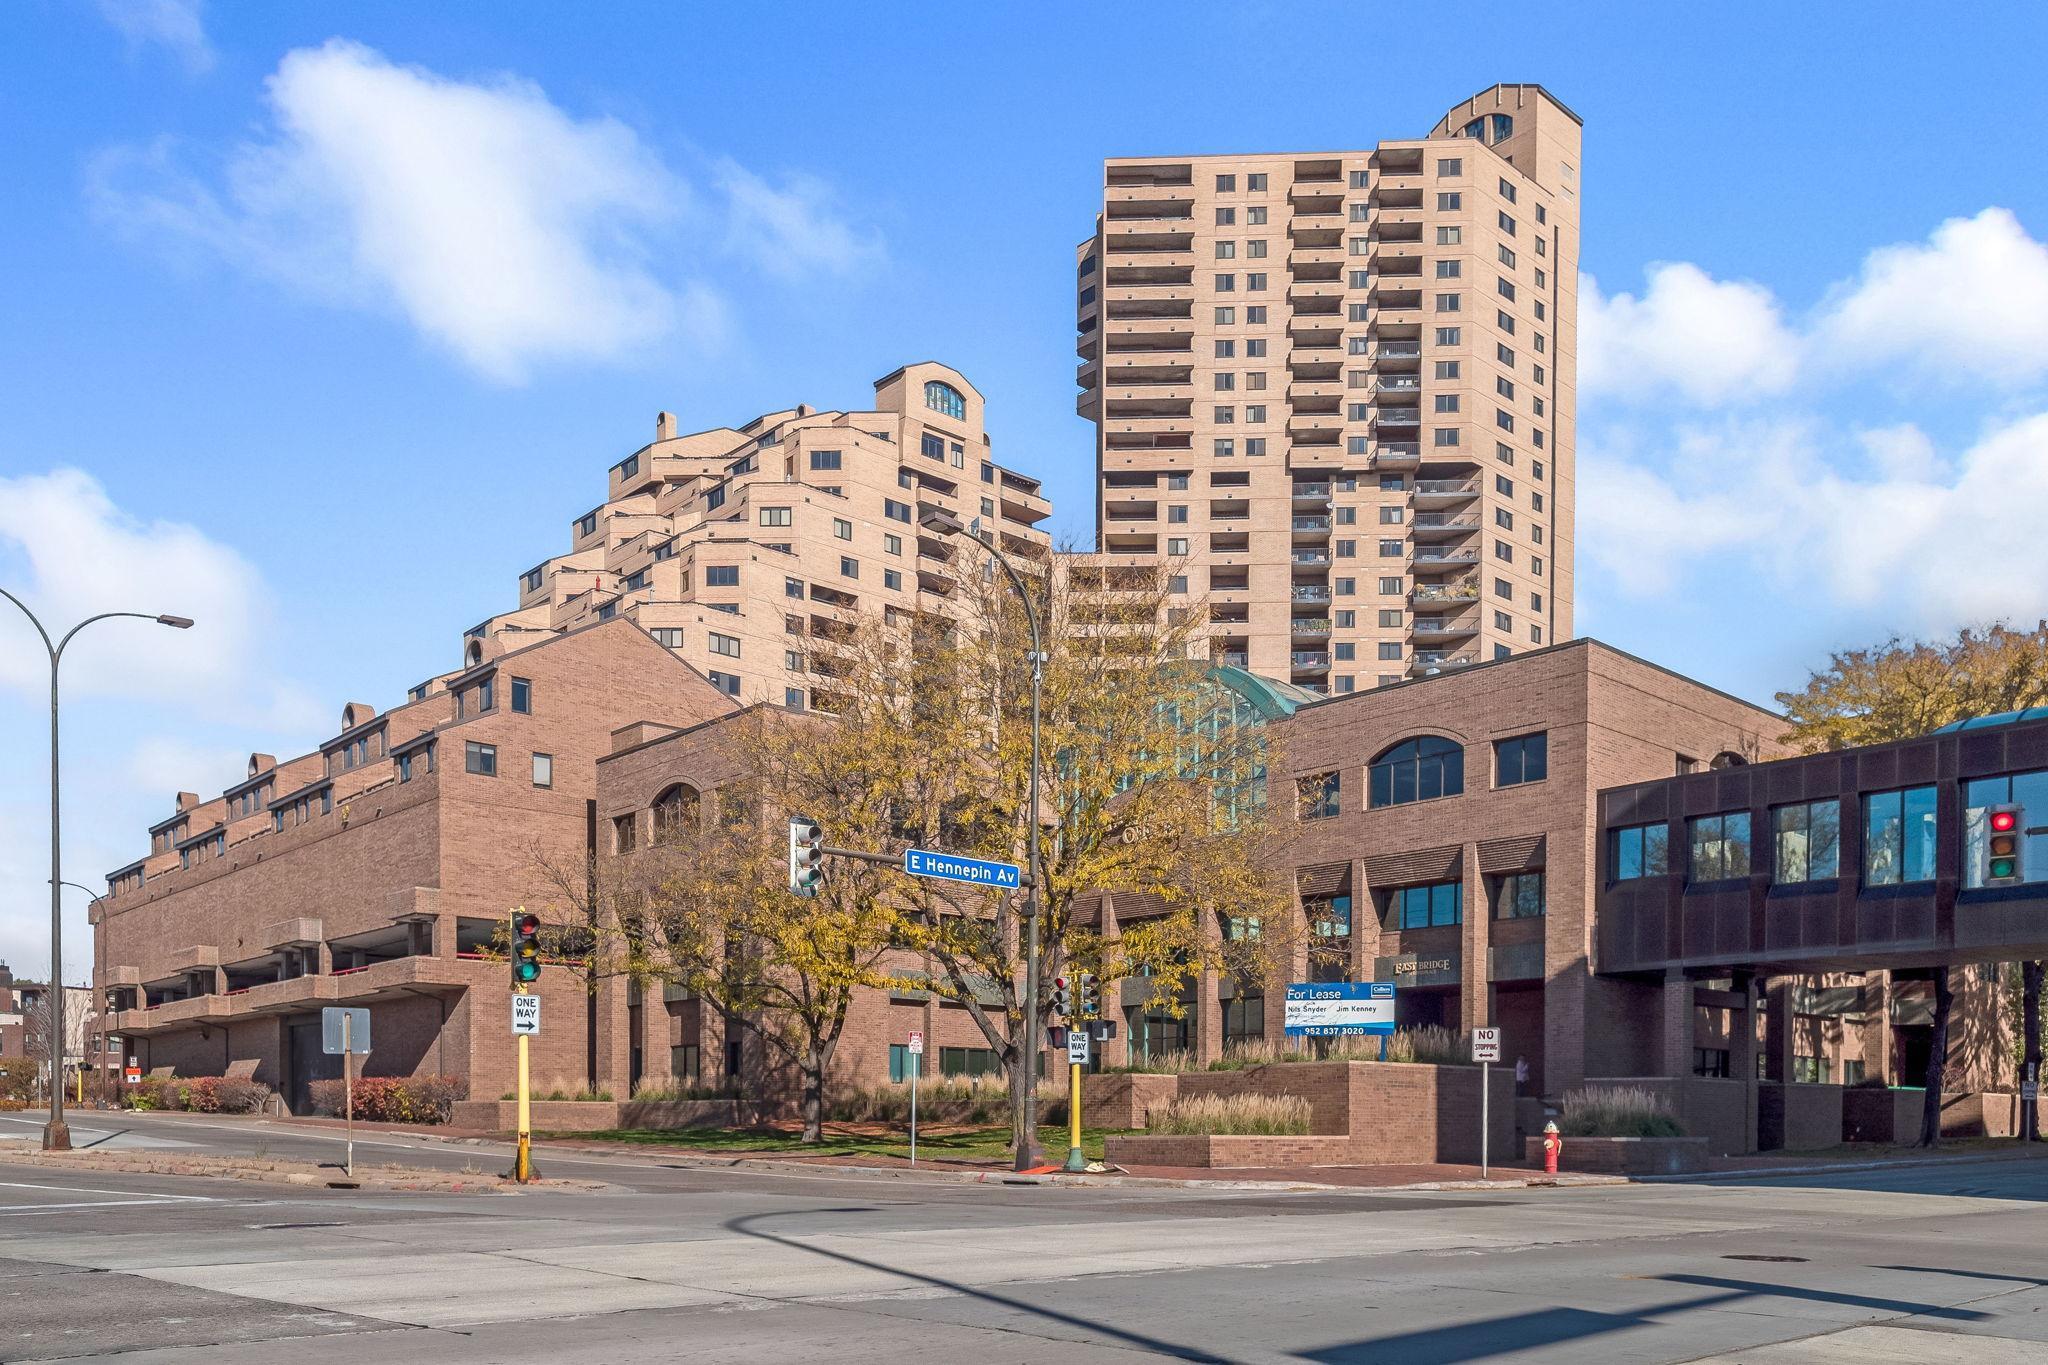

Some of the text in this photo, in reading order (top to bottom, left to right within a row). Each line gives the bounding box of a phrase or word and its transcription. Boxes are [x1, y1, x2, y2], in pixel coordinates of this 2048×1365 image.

[911, 855, 1014, 883] E Hennepin Av
[1287, 989, 1341, 1000] For Lease
[516, 997, 536, 1007] ONE
[515, 1008, 536, 1018] WAY
[1303, 1005, 1327, 1014] Snyder
[1351, 1005, 1377, 1014] Kenney
[1305, 1027, 1364, 1035] 952 837 3020
[1478, 1030, 1494, 1040] NO
[1071, 1034, 1086, 1042] ONE
[1071, 1042, 1087, 1050] WAY
[1474, 1043, 1498, 1051] STOPPING
